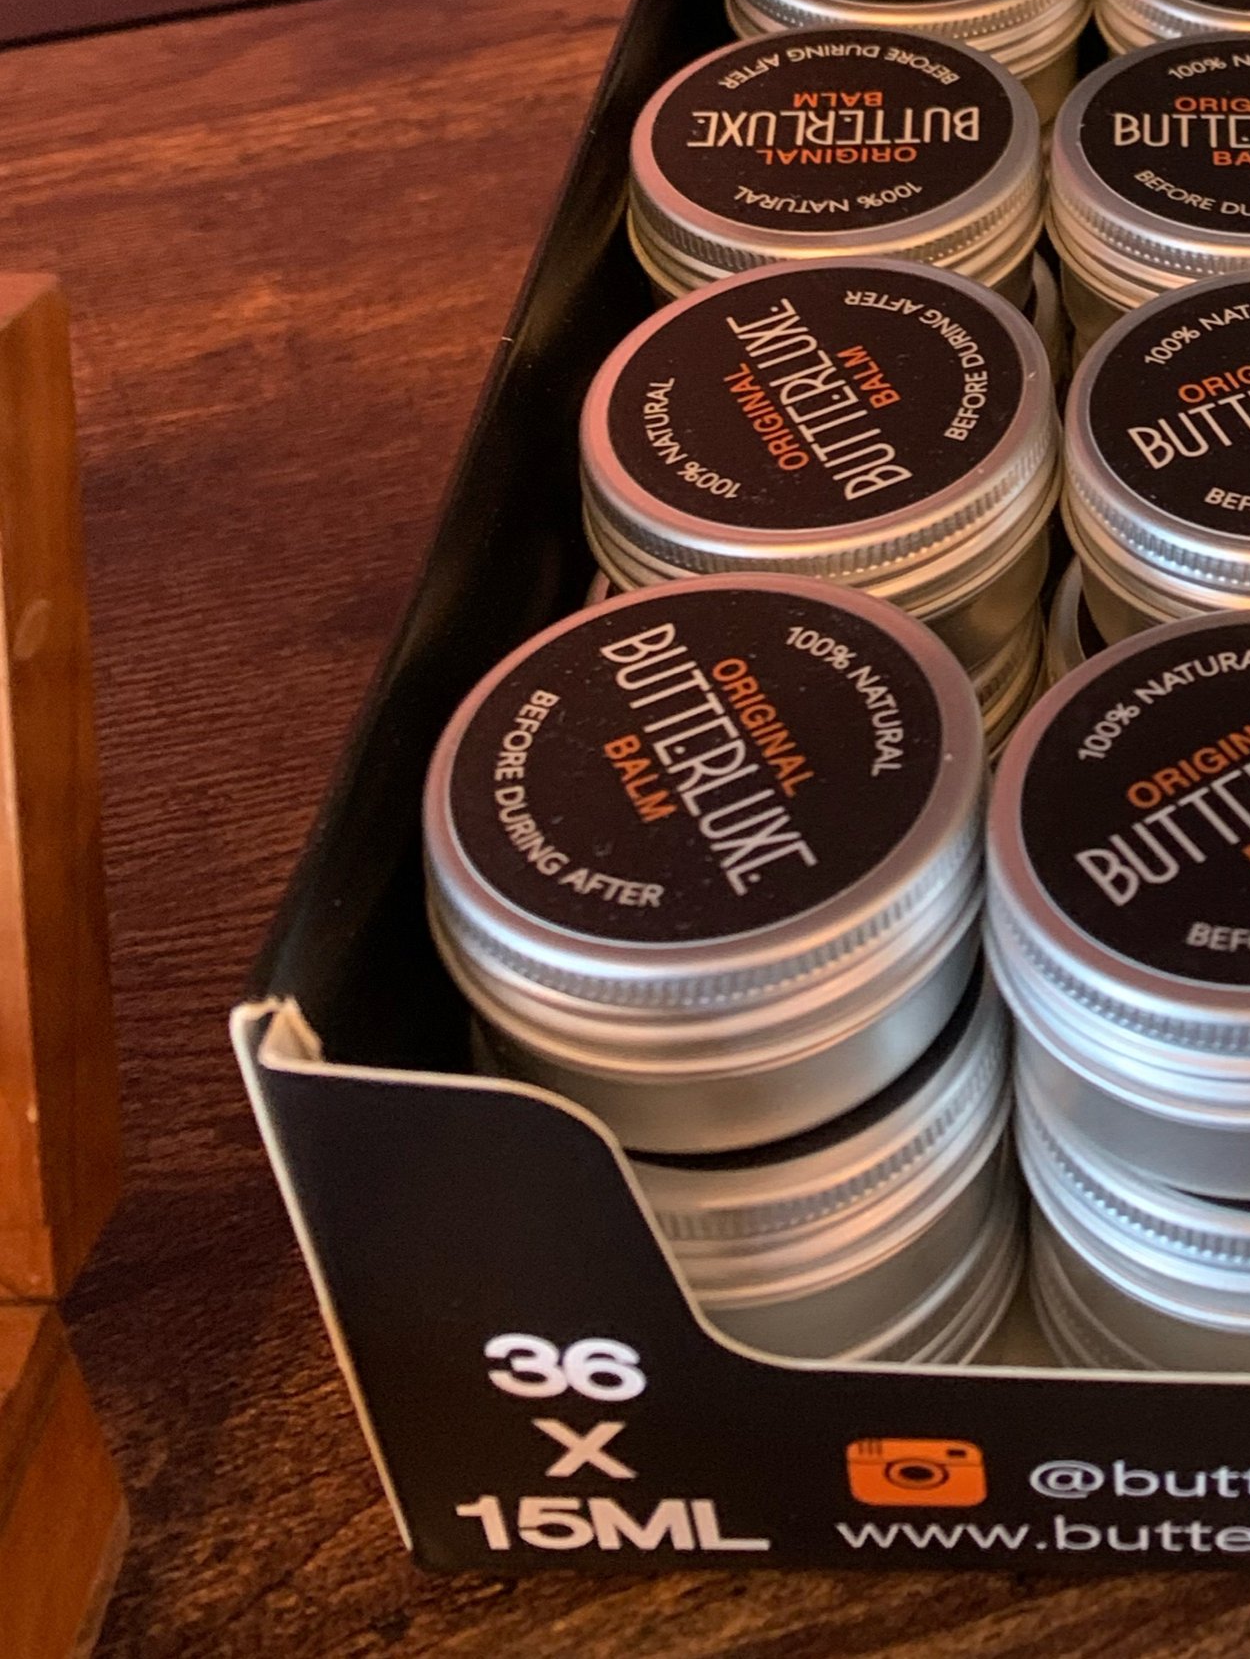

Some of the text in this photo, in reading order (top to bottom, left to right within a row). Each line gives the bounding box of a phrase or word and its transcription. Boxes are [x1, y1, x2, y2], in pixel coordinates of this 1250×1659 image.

[719, 44, 960, 89] BEFORE DURING AFTER
[1169, 57, 1227, 80] 100%
[687, 107, 979, 147] BUTTERLUXE
[794, 92, 882, 107] BALM
[757, 148, 916, 165] ORIGINAL
[734, 182, 923, 213] 100% NATURAL
[1135, 170, 1214, 211] BEFORE
[838, 345, 900, 409] BALM
[845, 290, 988, 440] BEFORE DURING AFTER
[1145, 326, 1200, 365] 100%
[724, 363, 809, 471] ORIGINAL
[727, 298, 913, 500] BUTTERLUXE
[644, 377, 741, 499] 100% NATURAL
[712, 658, 814, 797] ORIGINAL
[786, 626, 903, 776] 100% NATURAL
[1078, 702, 1141, 761] 100%
[600, 624, 817, 895] BUTTERLUXE
[604, 735, 677, 823] BALM
[495, 689, 664, 907] BEFORE DURING AFTER
[483, 1333, 648, 1402] 36
[532, 1417, 638, 1480] X
[455, 1494, 771, 1551] 15ML
